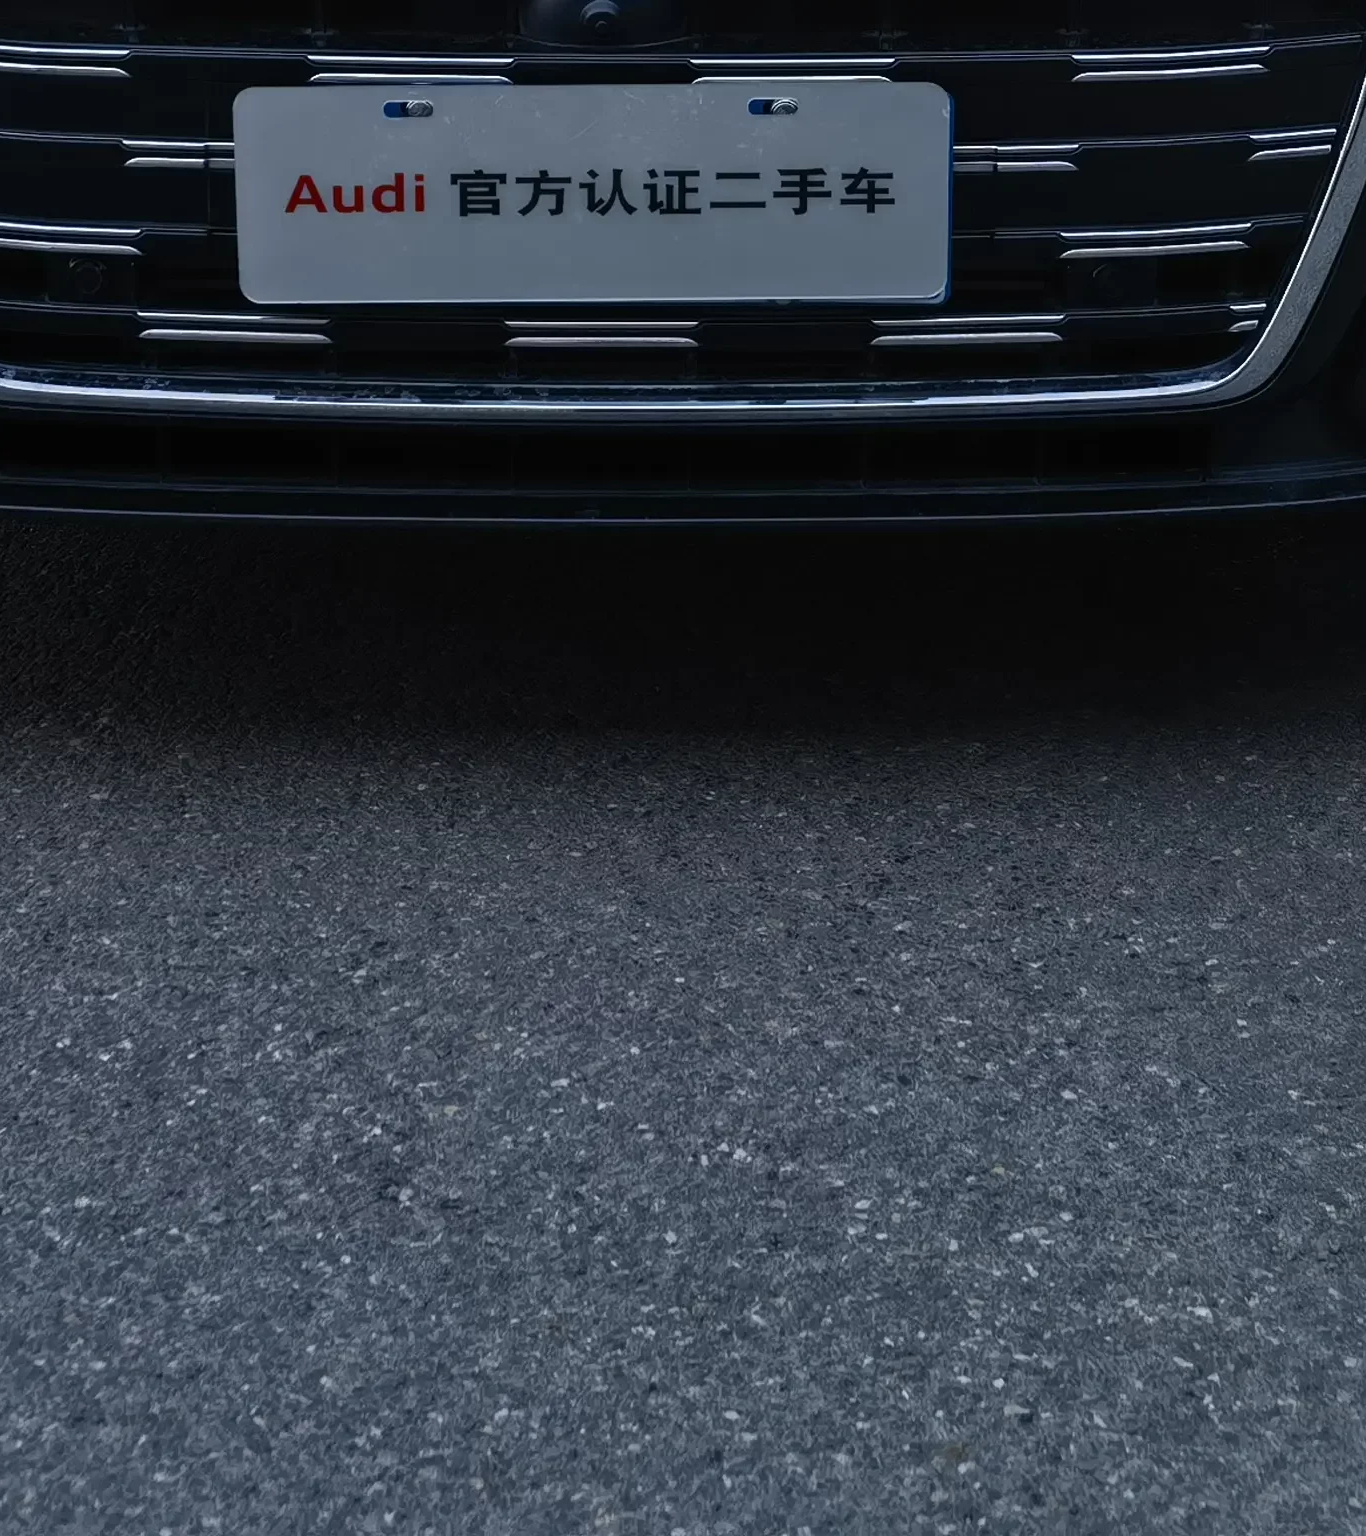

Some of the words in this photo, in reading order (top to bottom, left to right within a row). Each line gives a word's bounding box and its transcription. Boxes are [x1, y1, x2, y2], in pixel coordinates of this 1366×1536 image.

[285, 172, 426, 214] Audi
[450, 168, 897, 218] 官方认证二手车
